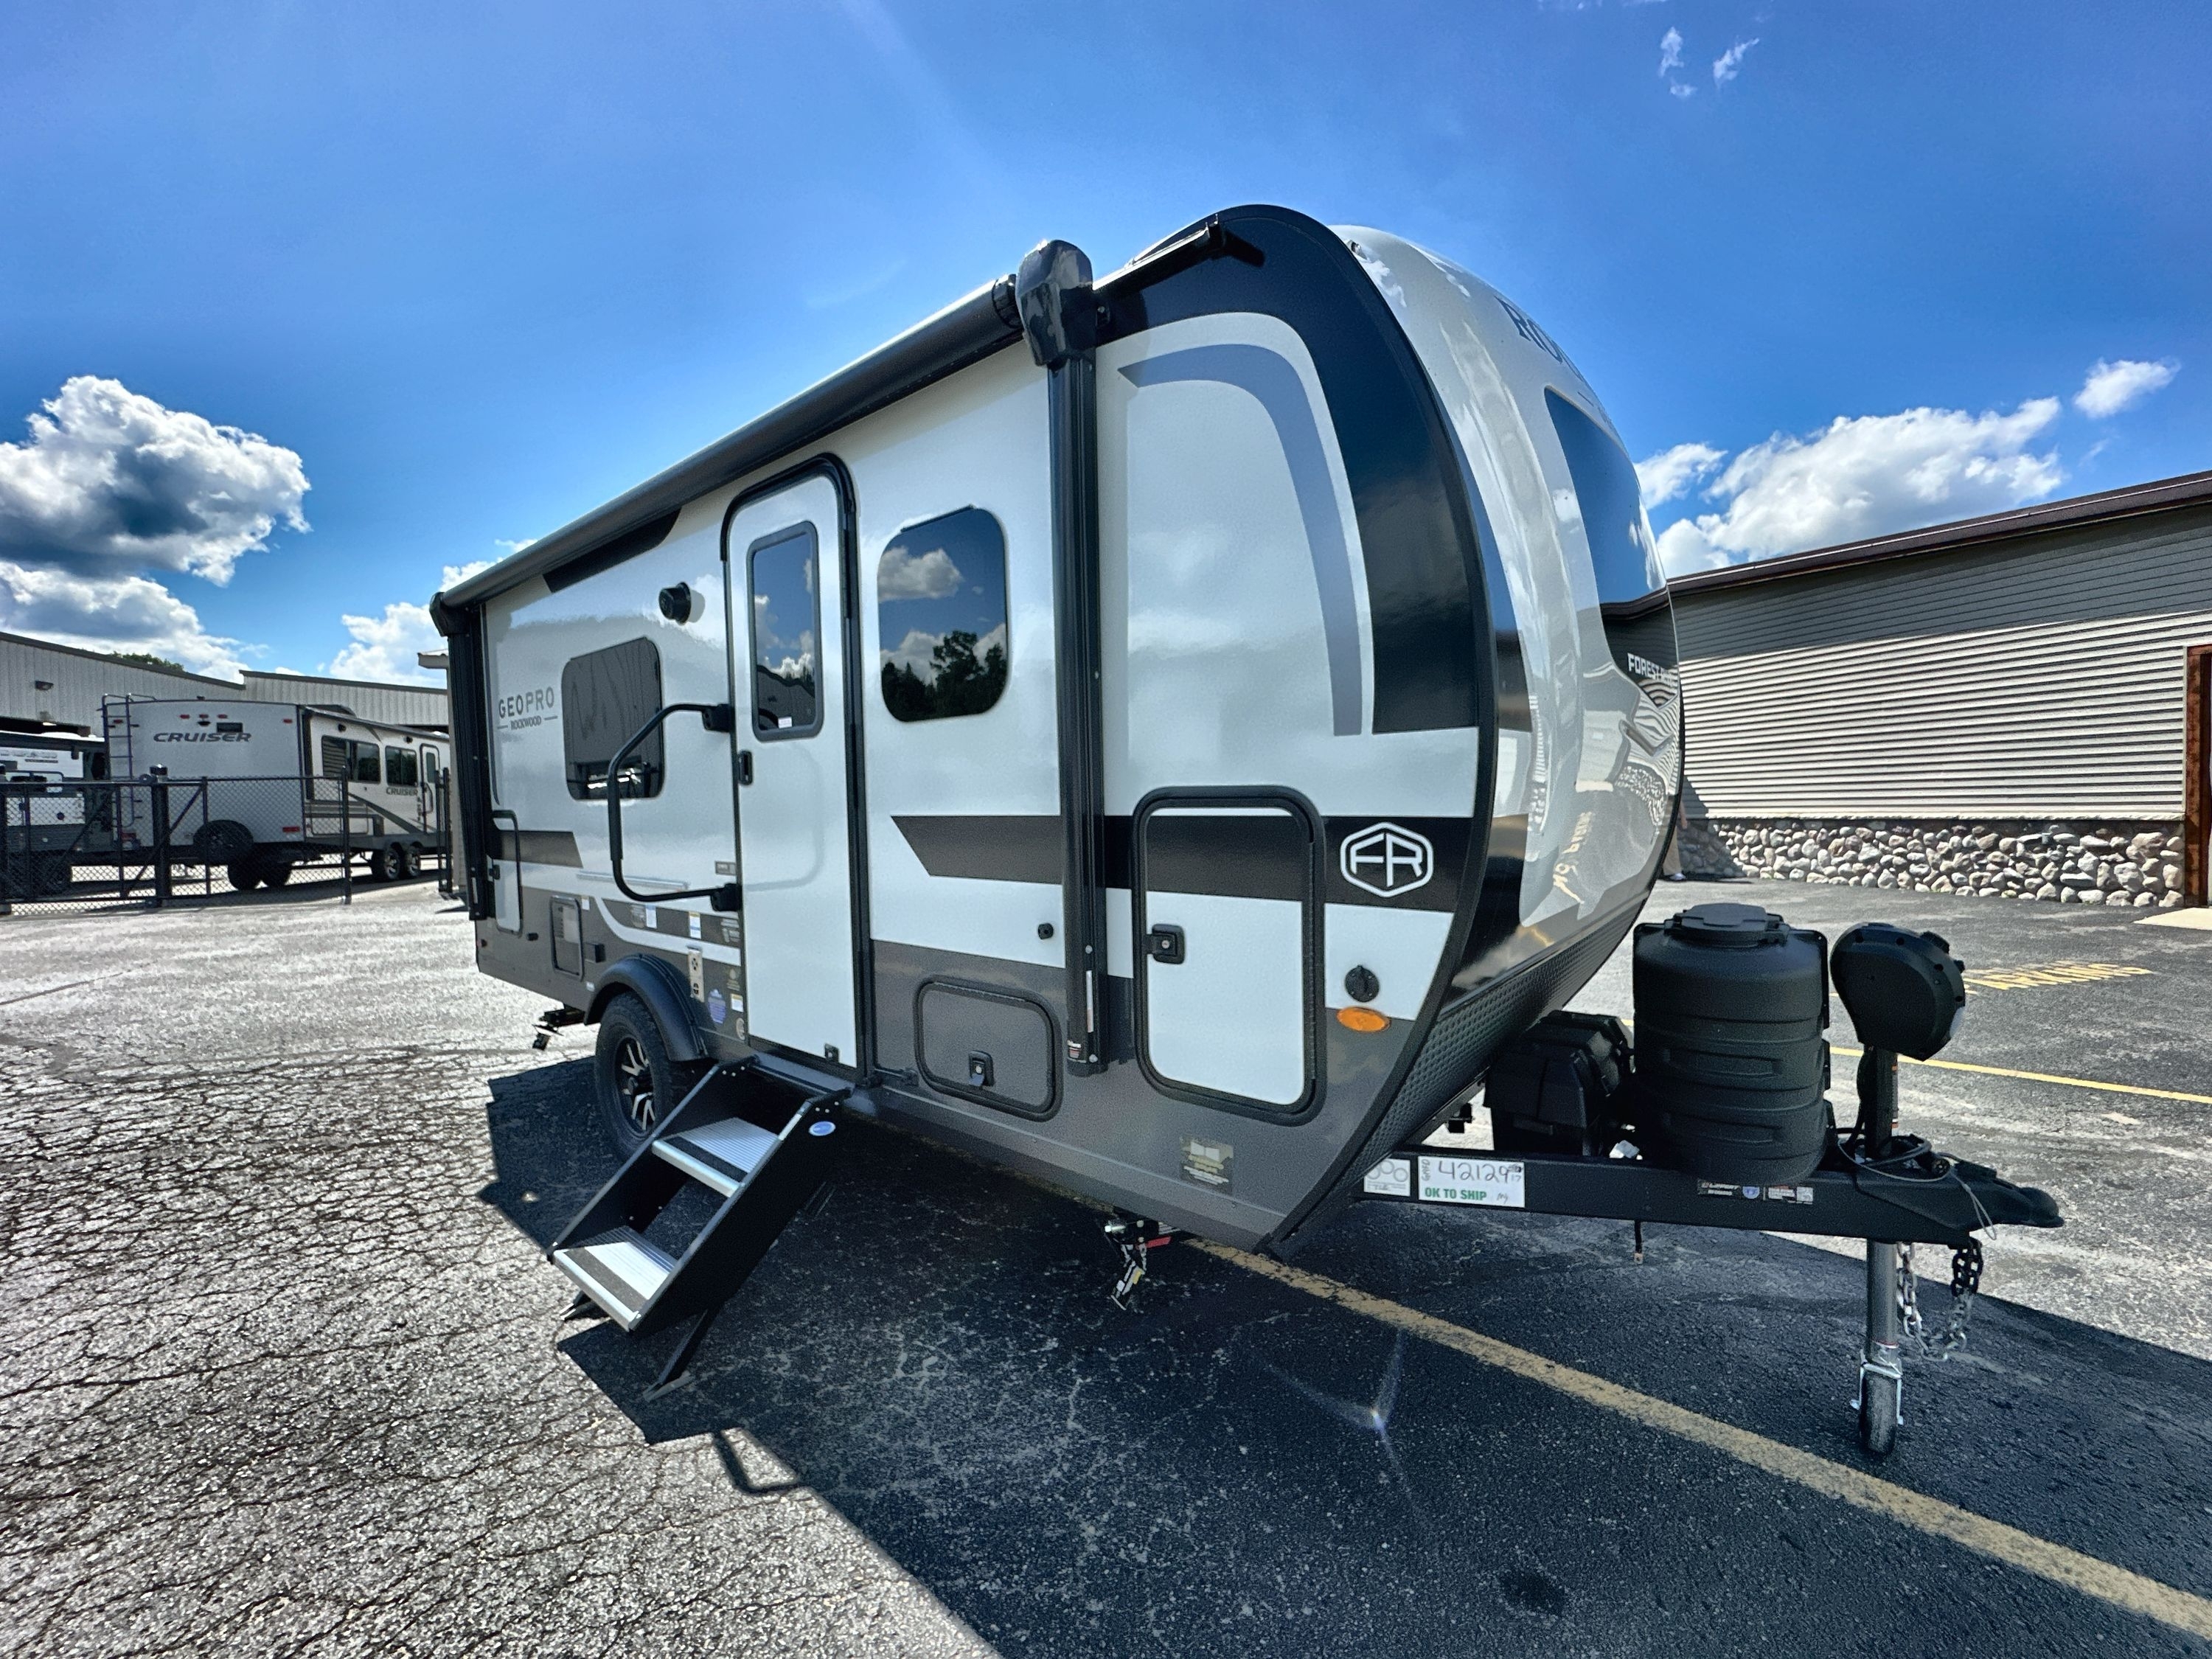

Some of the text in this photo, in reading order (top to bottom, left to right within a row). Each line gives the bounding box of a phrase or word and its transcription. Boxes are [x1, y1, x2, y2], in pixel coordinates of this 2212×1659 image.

[153, 732, 251, 742] CRUISER
[386, 787, 418, 796] CRUISER
[1439, 1161, 1509, 1183] 42129
[1425, 1187, 1487, 1201] OK TO SHIP
